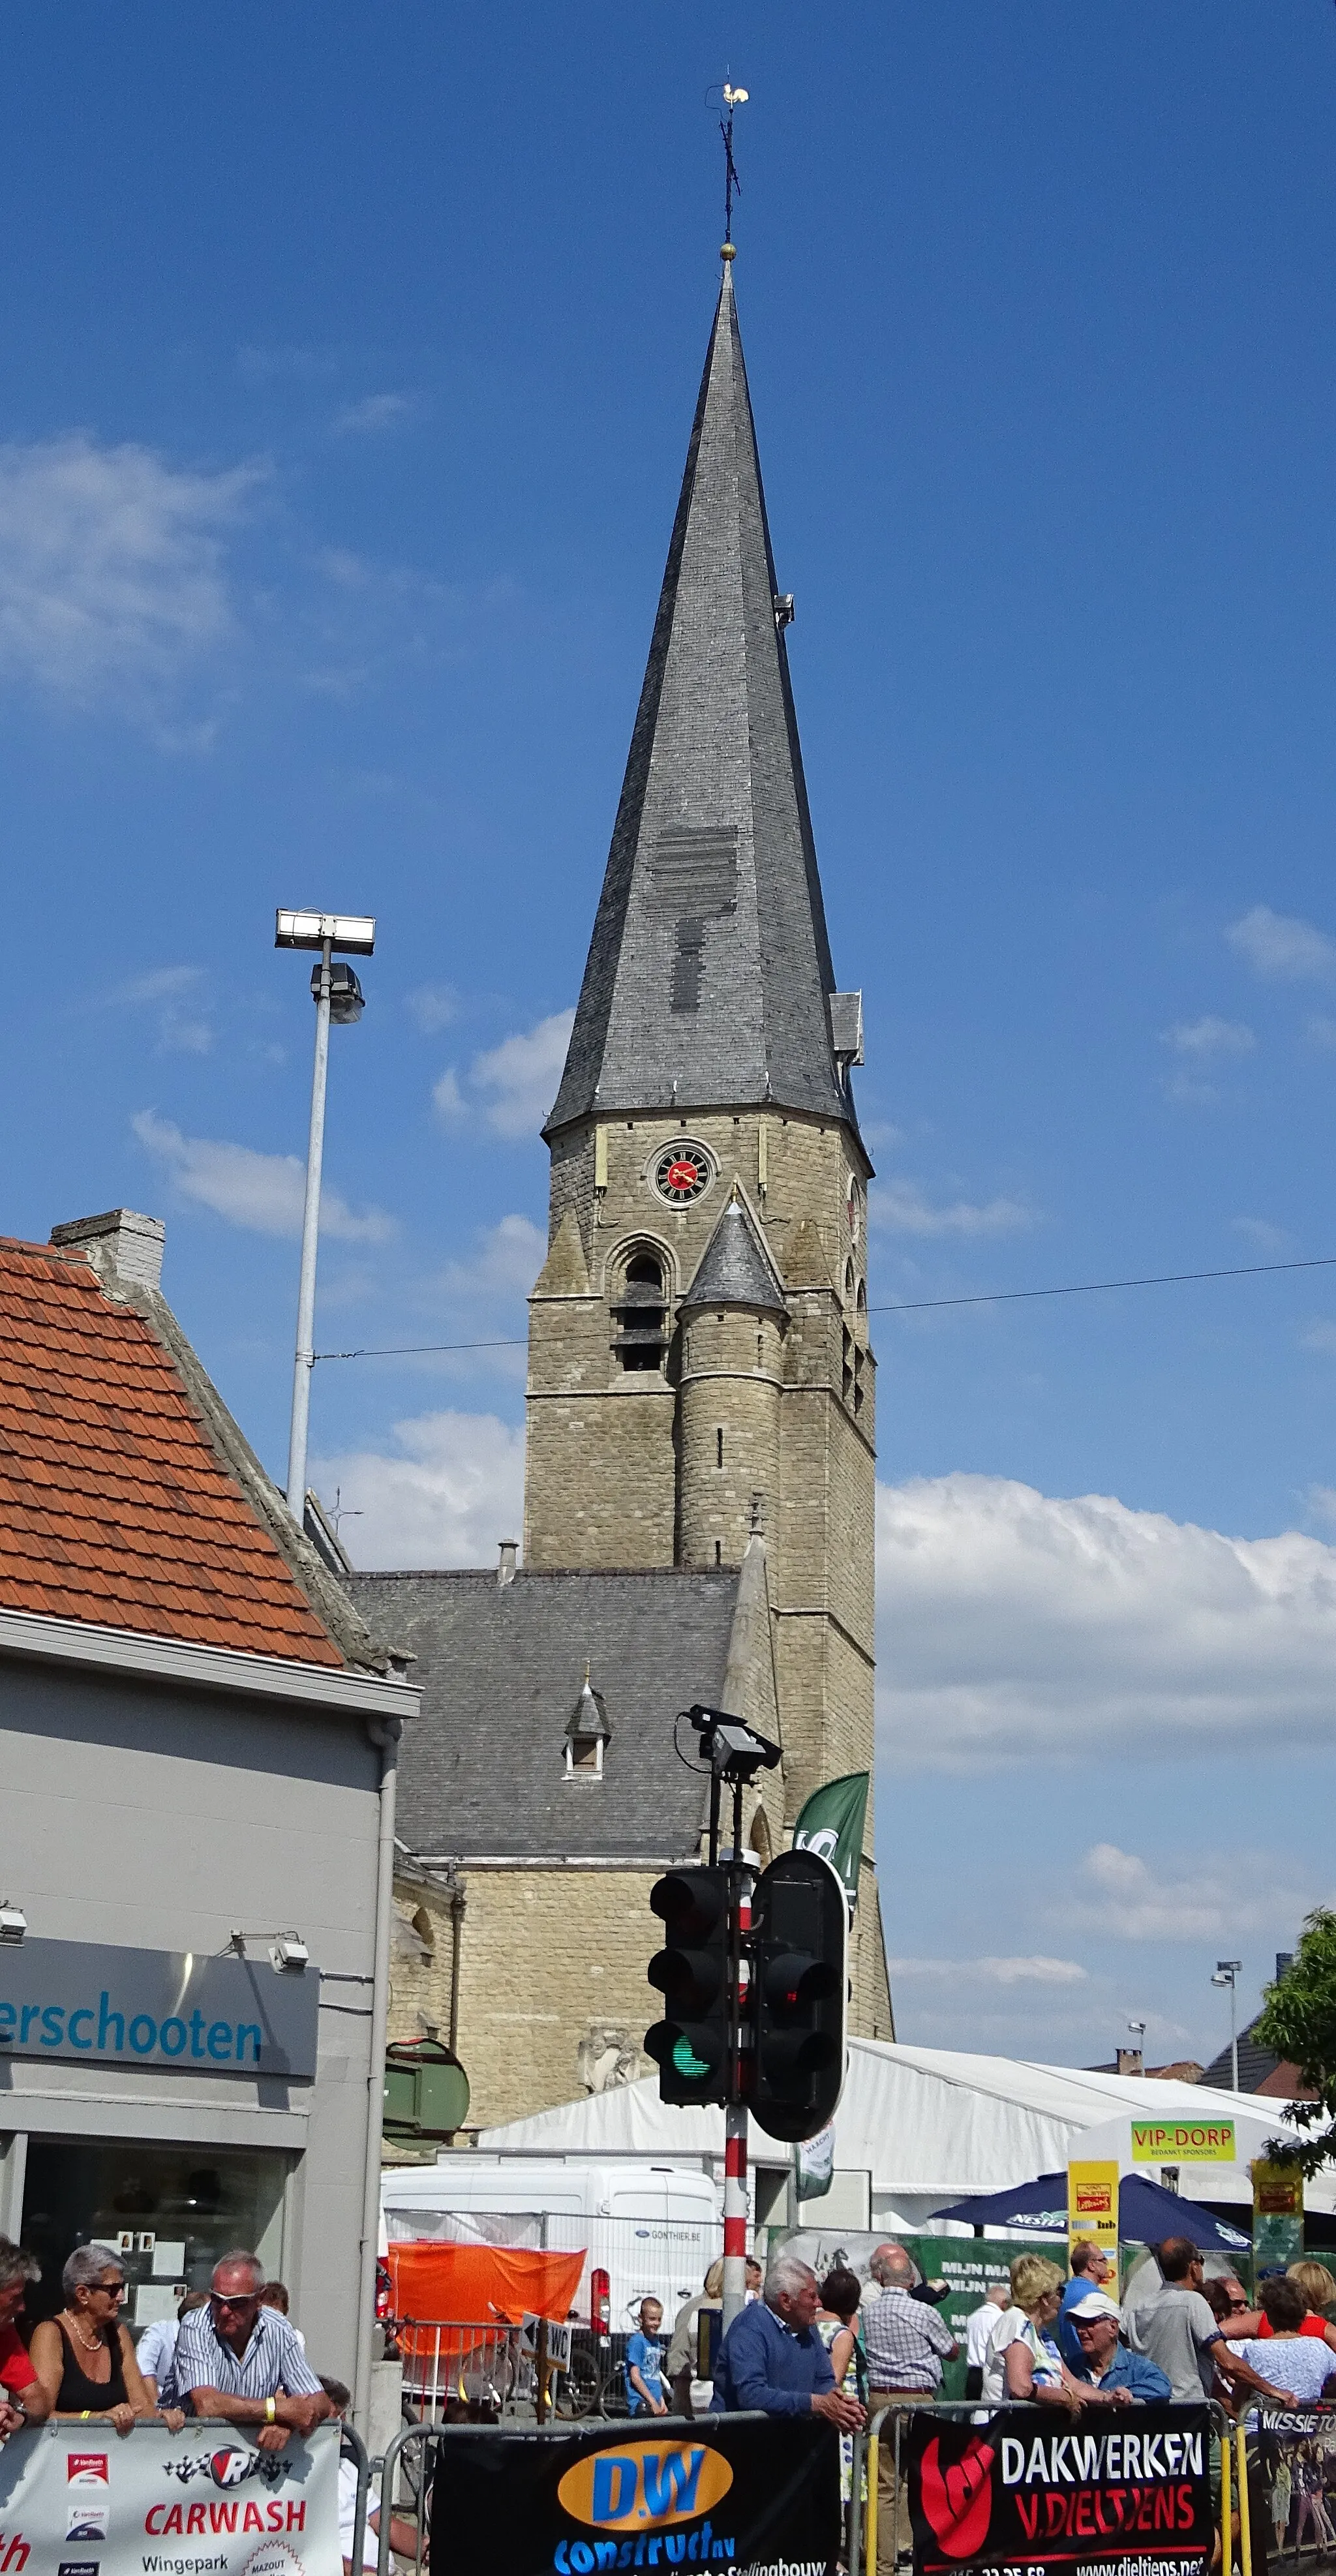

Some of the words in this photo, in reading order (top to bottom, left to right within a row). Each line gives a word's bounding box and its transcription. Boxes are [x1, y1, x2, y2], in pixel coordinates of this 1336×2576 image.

[1134, 2129, 1232, 2147] VIP-DORP
[652, 2230, 701, 2241] GONTHIER.BE
[941, 2261, 983, 2275] MIJN
[985, 2264, 1011, 2277] MA
[551, 2326, 568, 2359] WC
[1262, 2410, 1319, 2433] MISSIE
[1318, 2414, 1336, 2433] TO
[213, 2451, 250, 2482] VR
[1001, 2432, 1204, 2484] DAKWERKEN
[592, 2449, 705, 2522] D.W
[144, 2500, 307, 2536] CARWASH
[1014, 2483, 1196, 2540] V.DIELTJENS
[554, 2521, 713, 2575] construct
[143, 2554, 228, 2575] Wingepark
[252, 2559, 285, 2574] MAZOUT
